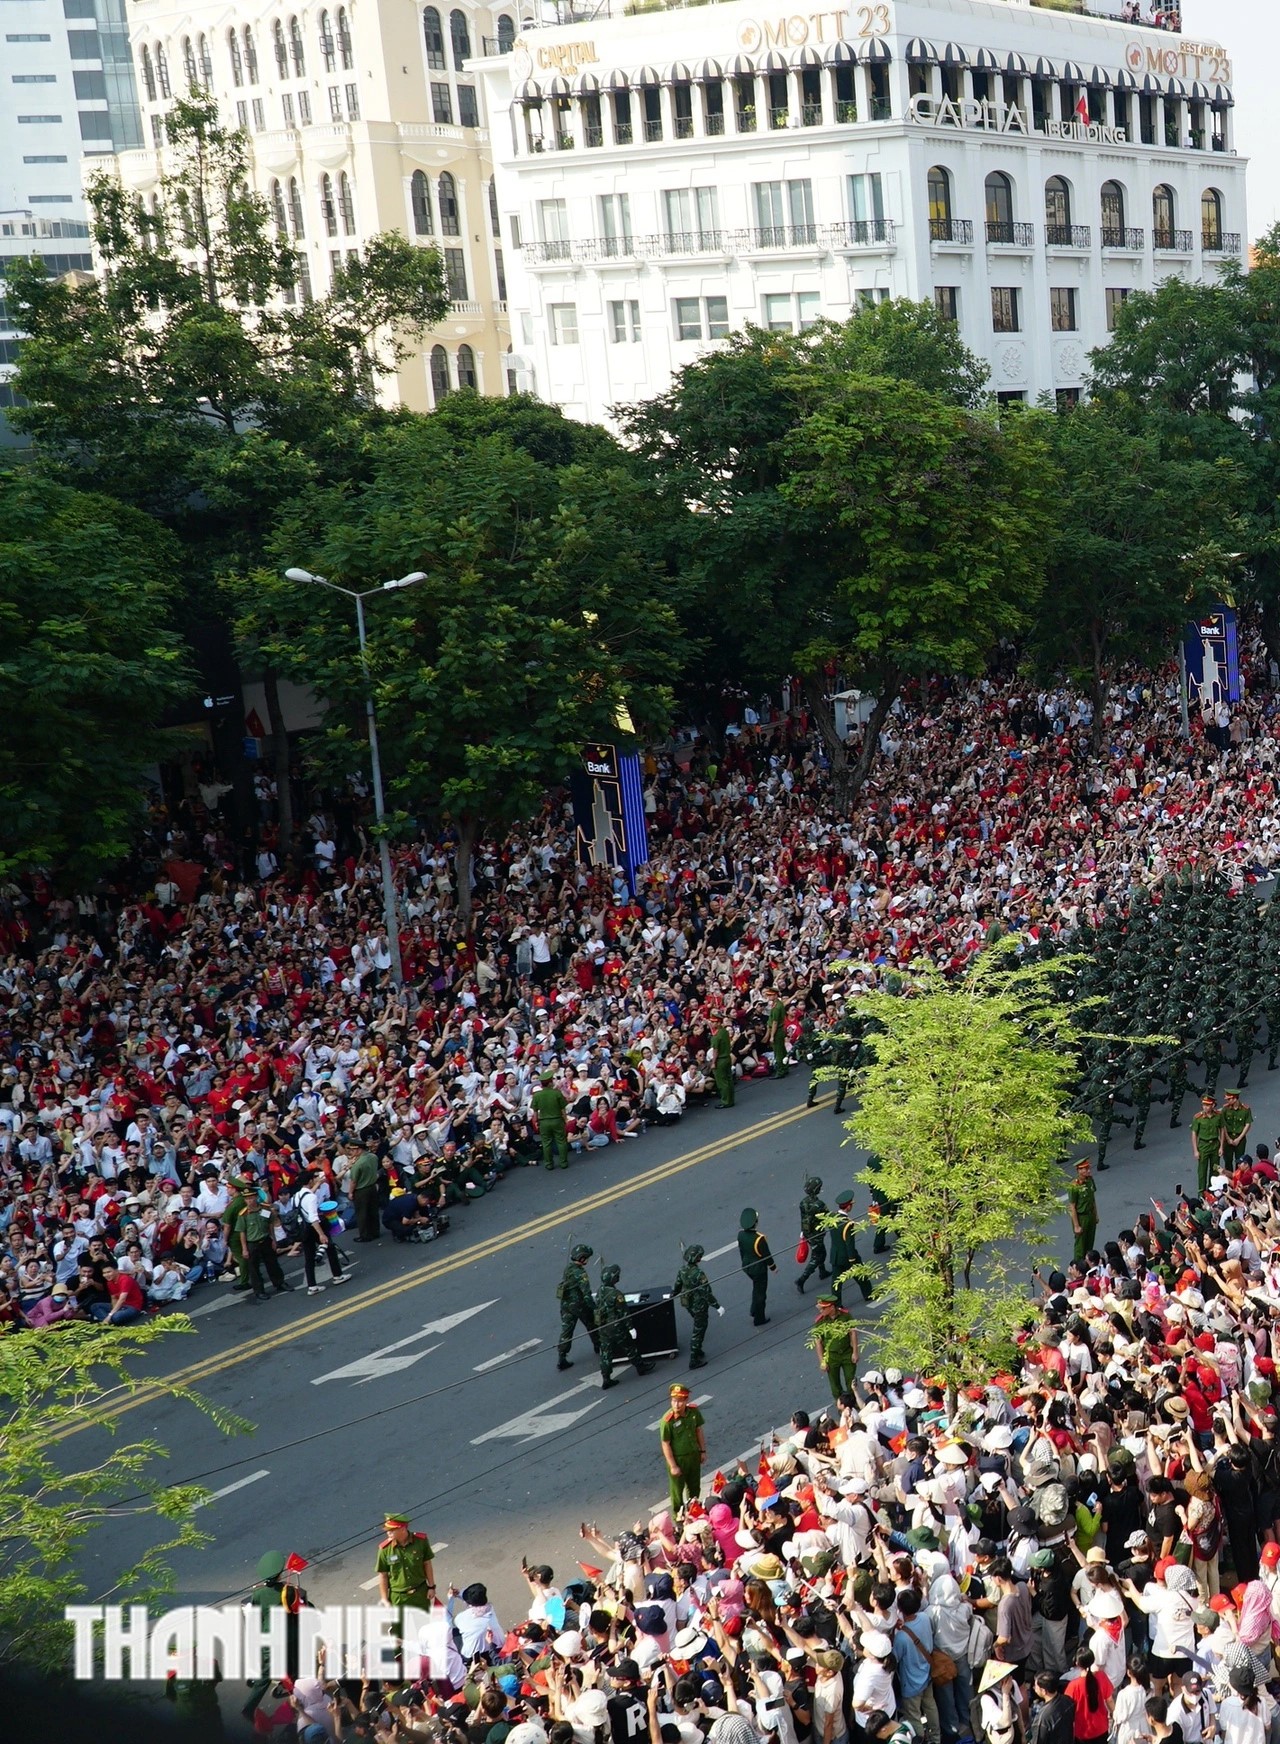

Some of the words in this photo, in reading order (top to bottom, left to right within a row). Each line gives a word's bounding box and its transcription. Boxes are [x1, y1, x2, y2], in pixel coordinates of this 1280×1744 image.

[764, 9, 849, 49] MOTT
[857, 4, 891, 38] 23
[537, 41, 600, 69] CAPITAL
[1146, 46, 1204, 79] MOTT
[1209, 57, 1230, 83] 23
[911, 92, 1044, 137] CAPITAL
[1046, 118, 1127, 144] BUILDING
[1201, 626, 1220, 635] Bank
[588, 762, 610, 773] Bank
[626, 1702, 647, 1738] R
